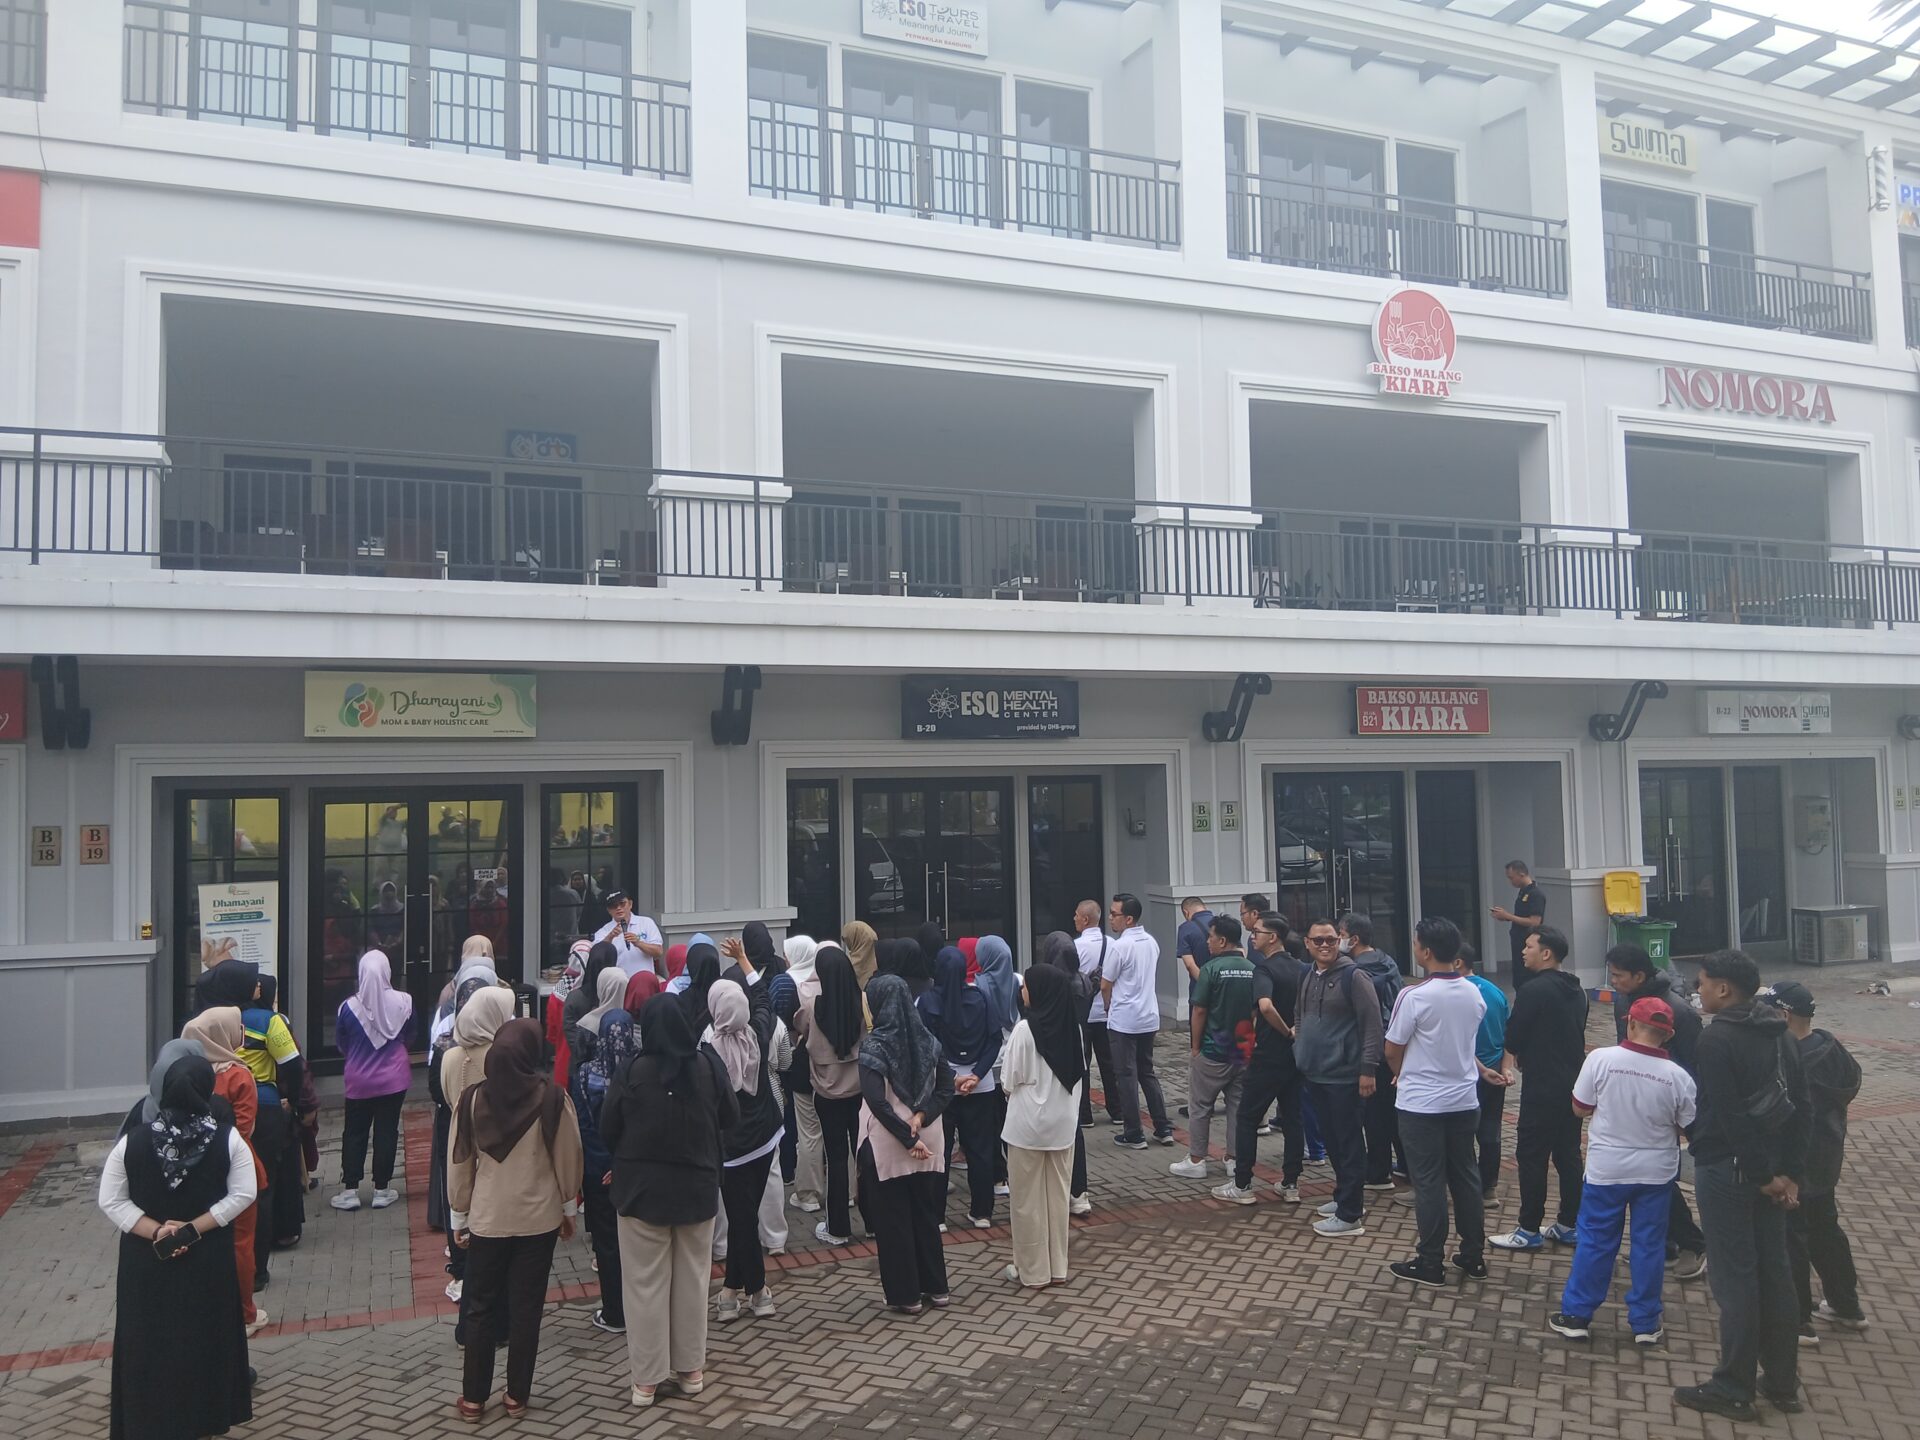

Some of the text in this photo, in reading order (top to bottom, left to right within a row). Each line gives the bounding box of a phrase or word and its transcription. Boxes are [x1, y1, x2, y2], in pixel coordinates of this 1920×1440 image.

[899, 0, 926, 20] ESQ
[929, 13, 979, 28] TRAVEL
[898, 18, 979, 41] Meaningful Journey
[1373, 363, 1462, 381] BAKSO MALANG
[1386, 375, 1450, 396] KIARA
[1661, 366, 1837, 422] NOMORA
[1003, 690, 1057, 700] MENTAL
[1368, 690, 1479, 705] BAKSO MALANG
[390, 690, 486, 718] Dhamayani
[960, 691, 1000, 718] ESQ
[1003, 700, 1058, 711] HEALTH
[1743, 705, 1797, 718] NOMORA
[1381, 706, 1469, 731] KIARA
[916, 724, 937, 732] B-20
[1016, 723, 1039, 731] provided
[1040, 724, 1047, 732] by
[1198, 805, 1206, 814] B
[1226, 804, 1233, 814] B
[1196, 819, 1208, 828] 20
[1224, 819, 1235, 827] 21
[41, 830, 53, 843] B
[89, 829, 101, 842] B
[38, 850, 55, 861] 18
[86, 848, 103, 860] 19
[212, 897, 265, 908] Dhamayani
